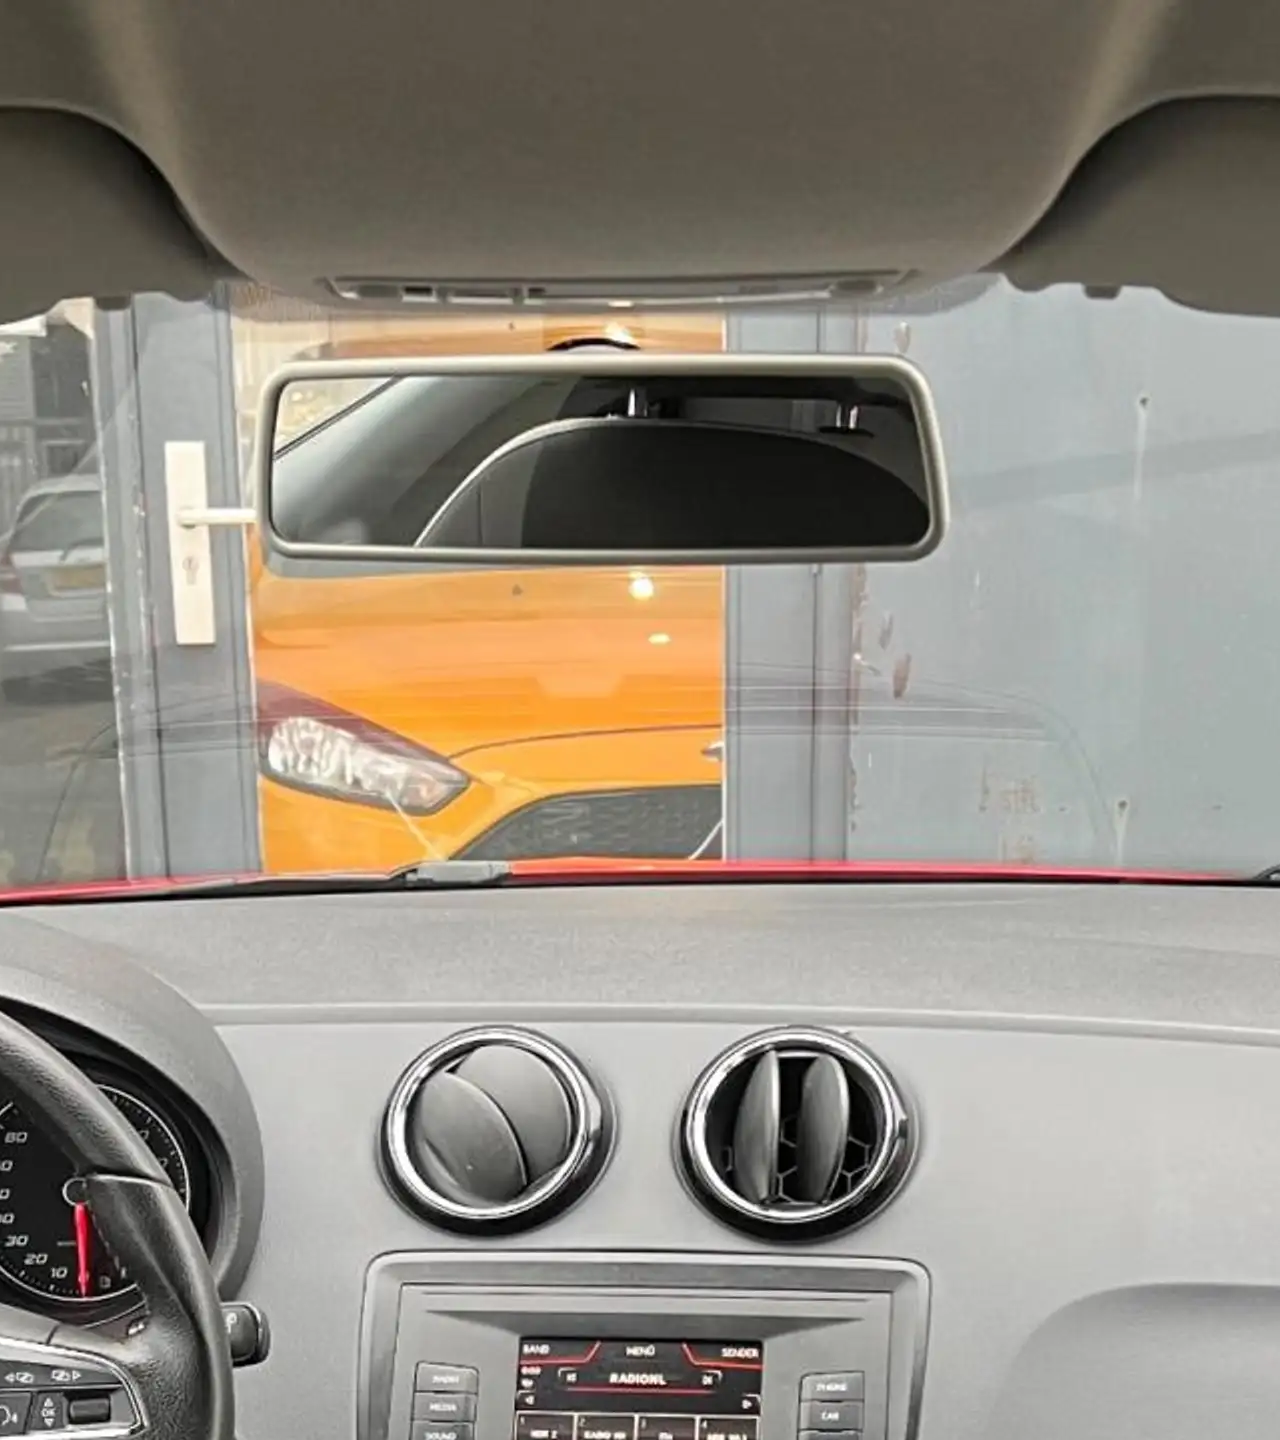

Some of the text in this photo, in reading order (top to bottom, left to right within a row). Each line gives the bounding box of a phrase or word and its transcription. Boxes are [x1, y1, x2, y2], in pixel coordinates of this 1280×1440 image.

[4, 1130, 29, 1145] 80
[4, 1234, 29, 1249] 30
[23, 1252, 49, 1267] 20
[50, 1266, 69, 1280] 10
[609, 1372, 668, 1386] RADIONL
